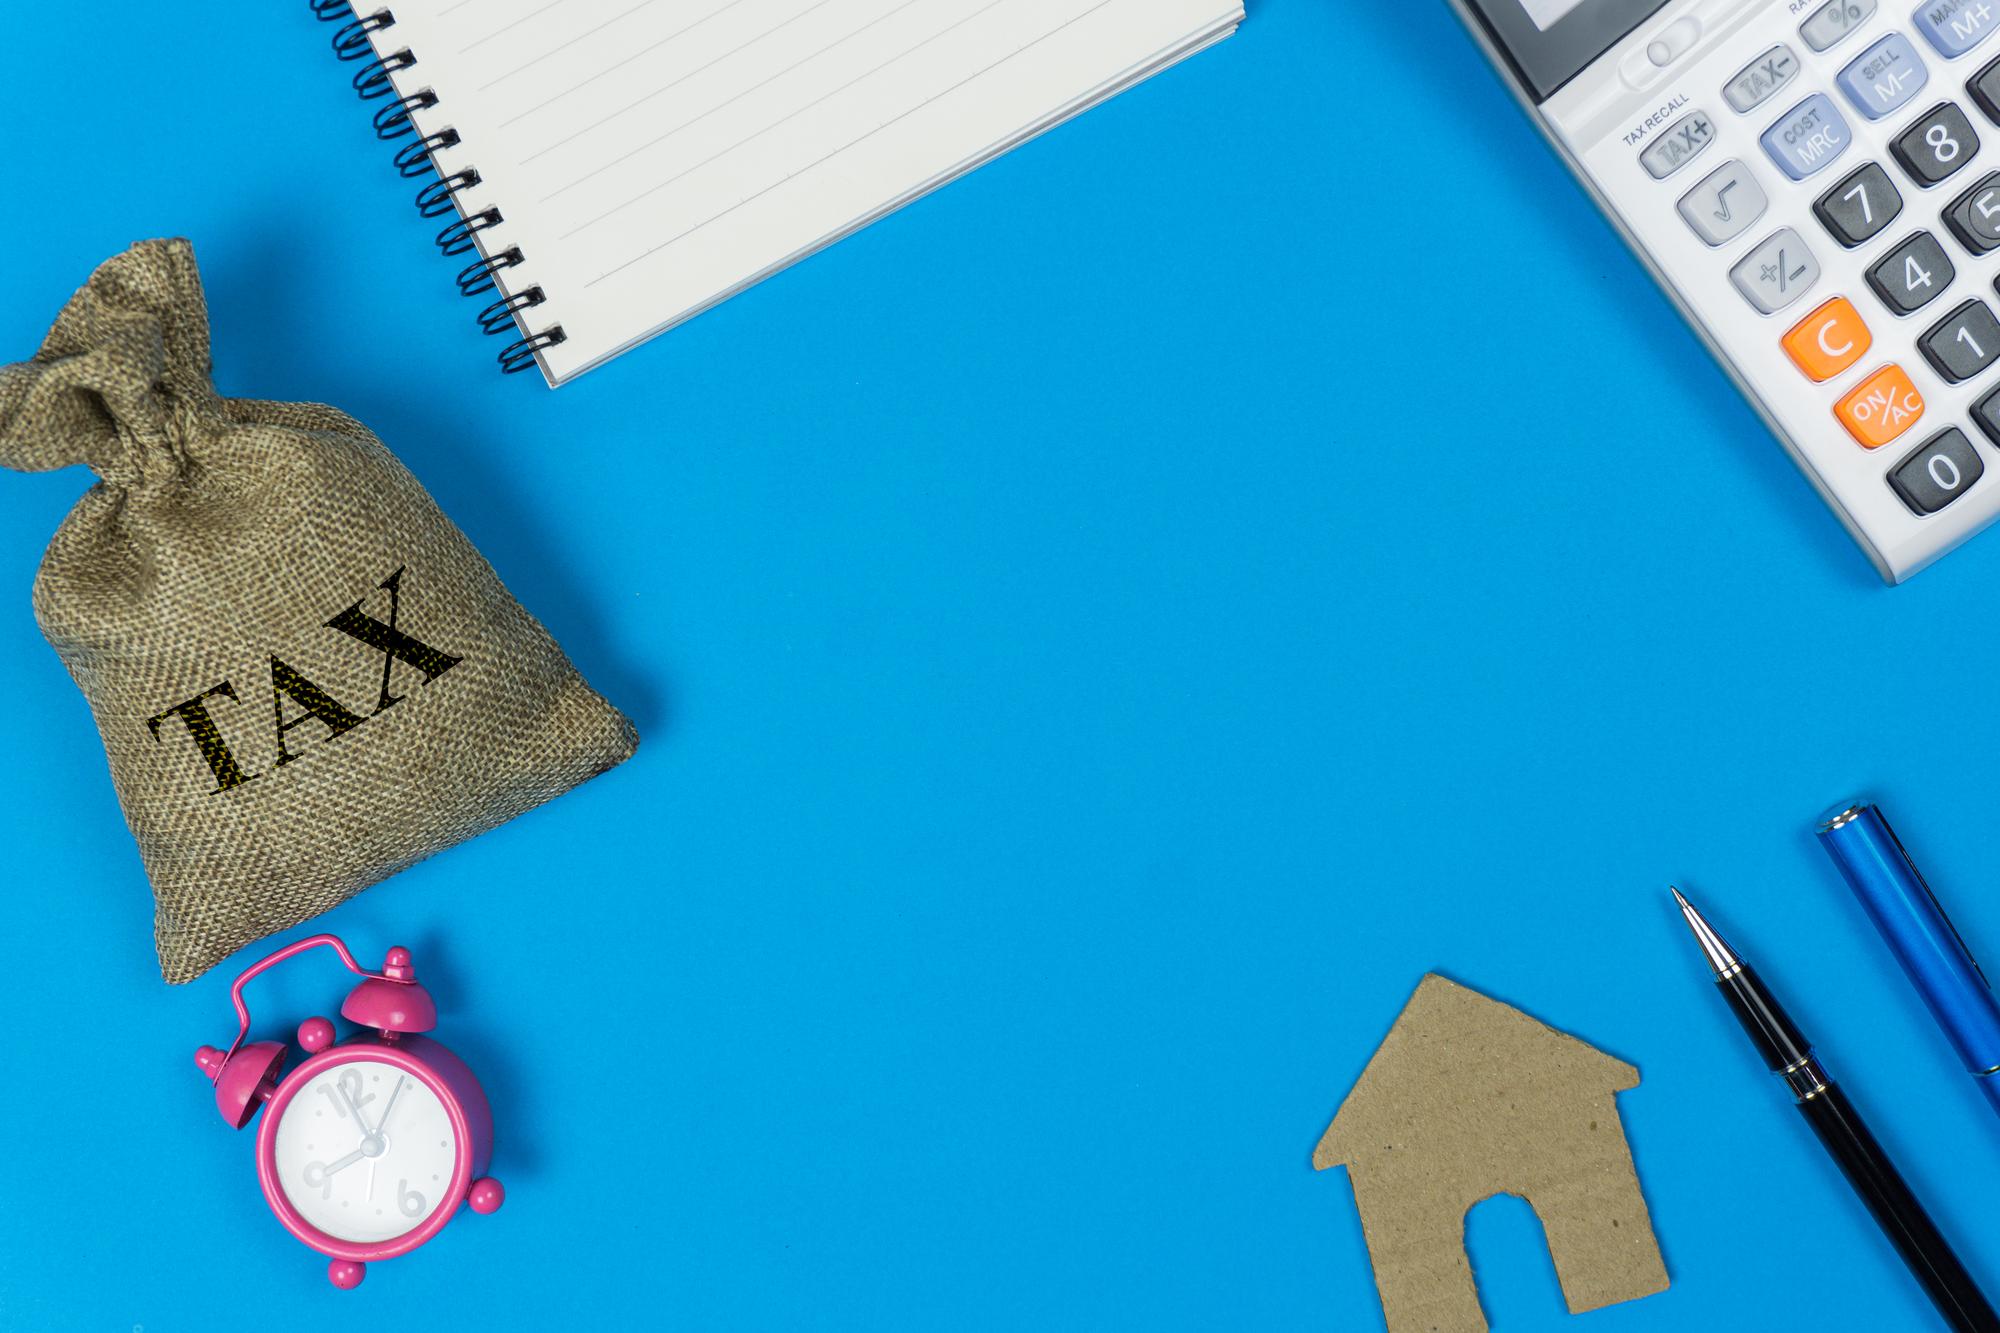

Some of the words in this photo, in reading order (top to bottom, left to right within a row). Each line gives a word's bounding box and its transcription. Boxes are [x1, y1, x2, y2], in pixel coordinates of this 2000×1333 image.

[1827, 0, 1861, 28] %
[1951, 3, 1991, 40] M+
[1738, 57, 1790, 100] TAX-
[1862, 50, 1900, 80] SELL
[1874, 68, 1913, 103] M-
[1622, 125, 1647, 146] TAX
[1644, 94, 1690, 130] RECALL
[1783, 108, 1822, 145] COST
[1656, 120, 1708, 166] TAX+
[1797, 125, 1840, 166] MRC
[1925, 124, 1960, 162] 8
[1843, 183, 1873, 224] 7
[1905, 255, 1932, 291] 4
[1817, 319, 1854, 357] C
[1956, 326, 1985, 358] 1
[1927, 454, 1961, 490] 0
[145, 564, 464, 796] TAX
[316, 1068, 376, 1118] 12
[303, 1160, 332, 1200] 9
[397, 1178, 427, 1218] 6
